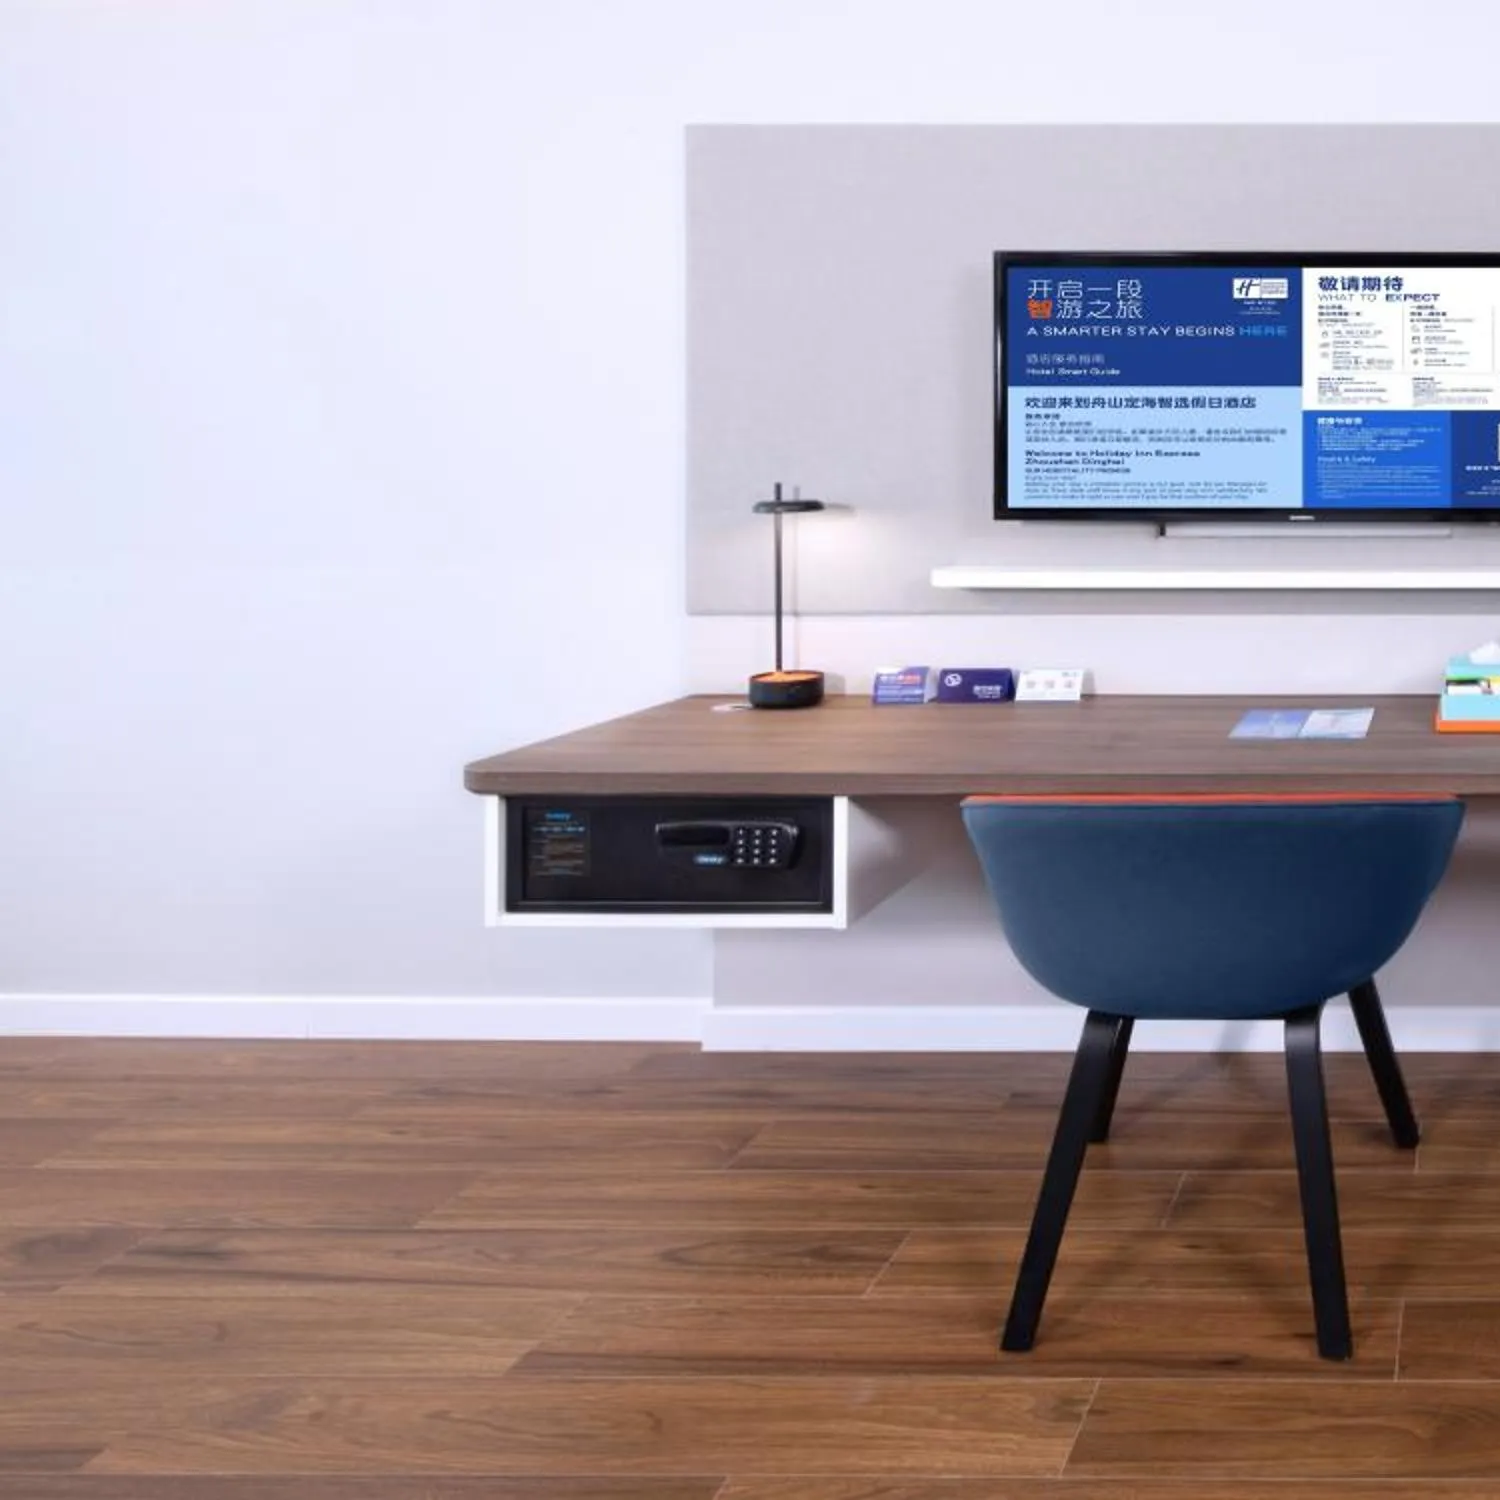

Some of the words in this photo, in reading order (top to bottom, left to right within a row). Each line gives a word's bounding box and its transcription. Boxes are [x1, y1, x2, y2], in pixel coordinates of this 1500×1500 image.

[1027, 278, 1144, 300] 开启一段
[1318, 275, 1405, 292] 敬请期待
[1318, 293, 1355, 302] WHAT
[1360, 293, 1377, 302] TO
[1384, 293, 1441, 302] EXPECT
[1027, 299, 1144, 320] 智游之旅
[1026, 325, 1038, 337] A
[1043, 325, 1122, 337] SMARTER
[1127, 325, 1171, 337] STAY
[1175, 325, 1235, 337] BEGINS
[1239, 325, 1287, 337] HERE
